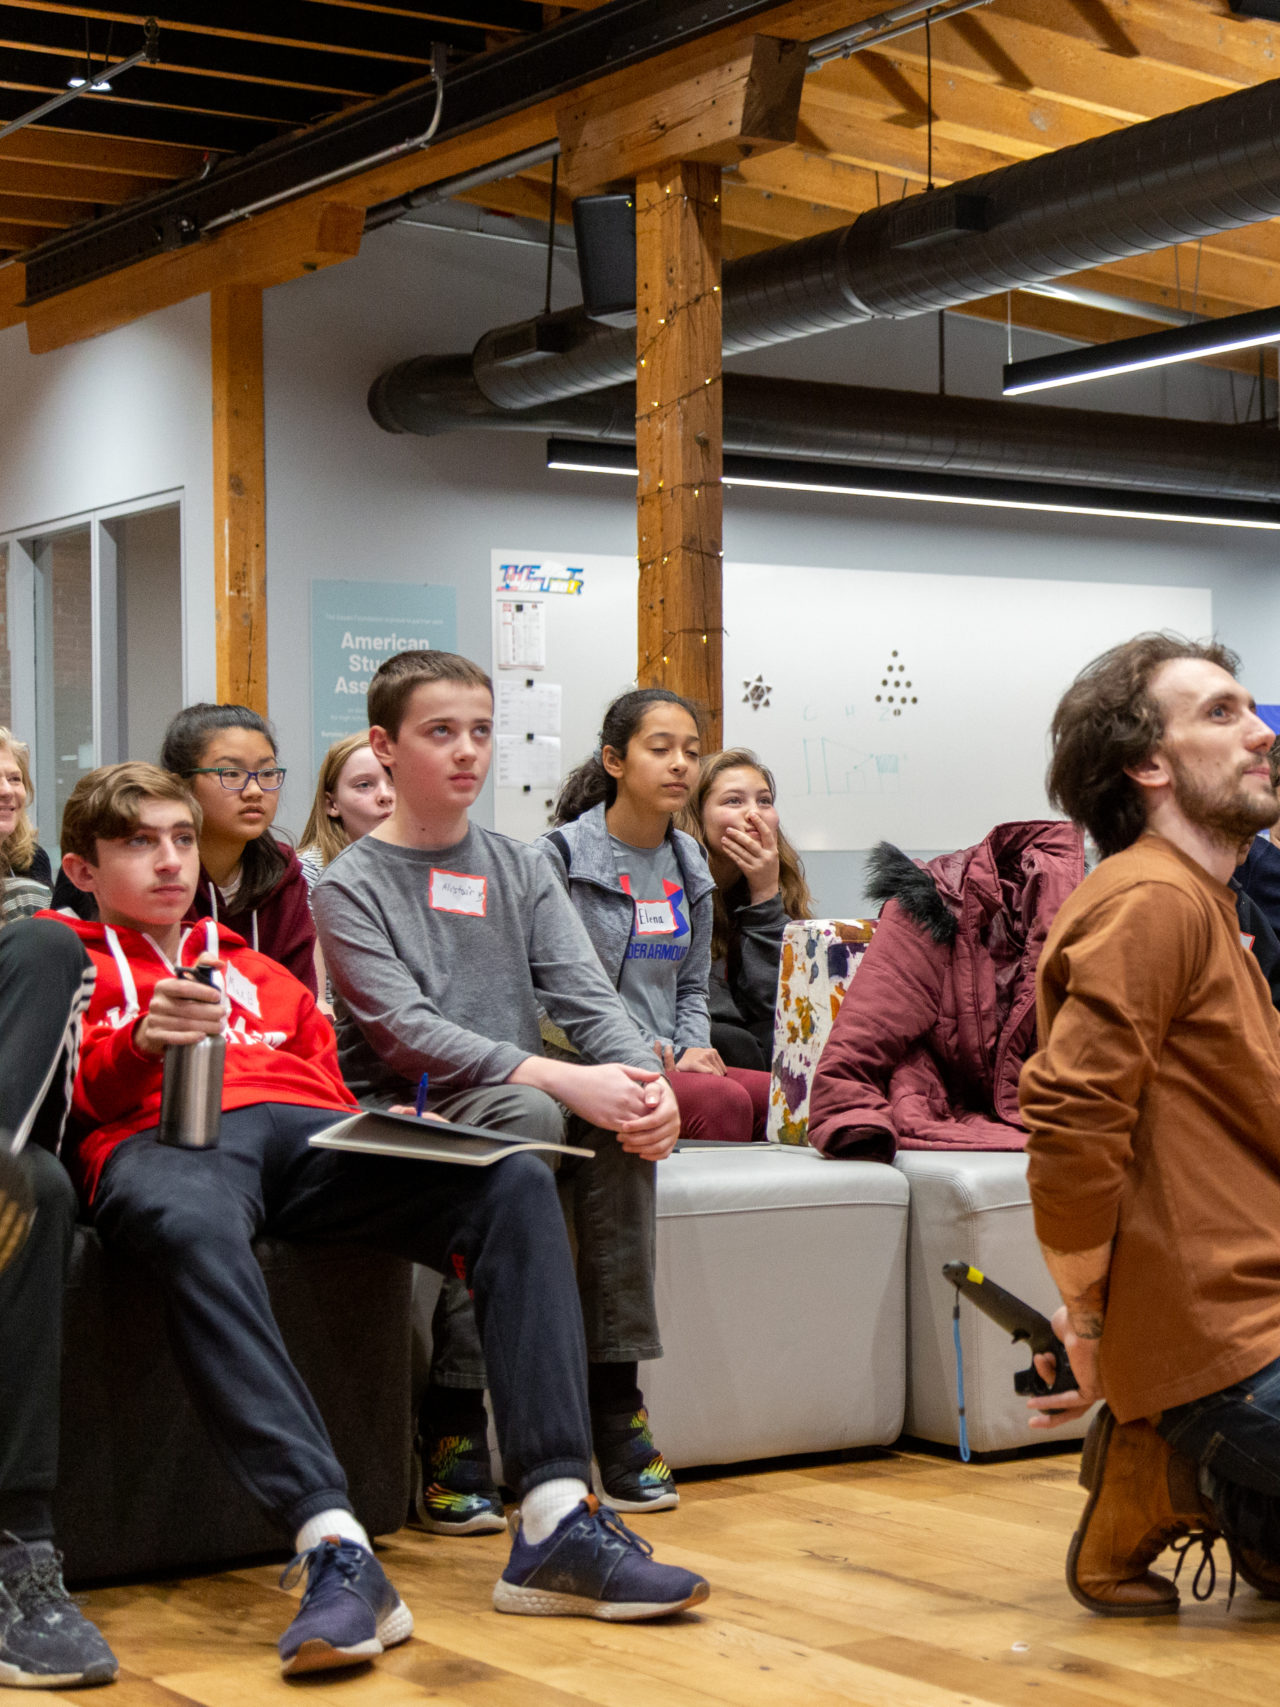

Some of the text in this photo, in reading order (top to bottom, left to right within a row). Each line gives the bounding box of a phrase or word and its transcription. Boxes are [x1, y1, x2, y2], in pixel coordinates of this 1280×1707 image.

[341, 632, 430, 650] American
[348, 654, 384, 673] Stu
[334, 677, 370, 695] Ass
[638, 906, 664, 925] Elena
[625, 943, 647, 960] DER
